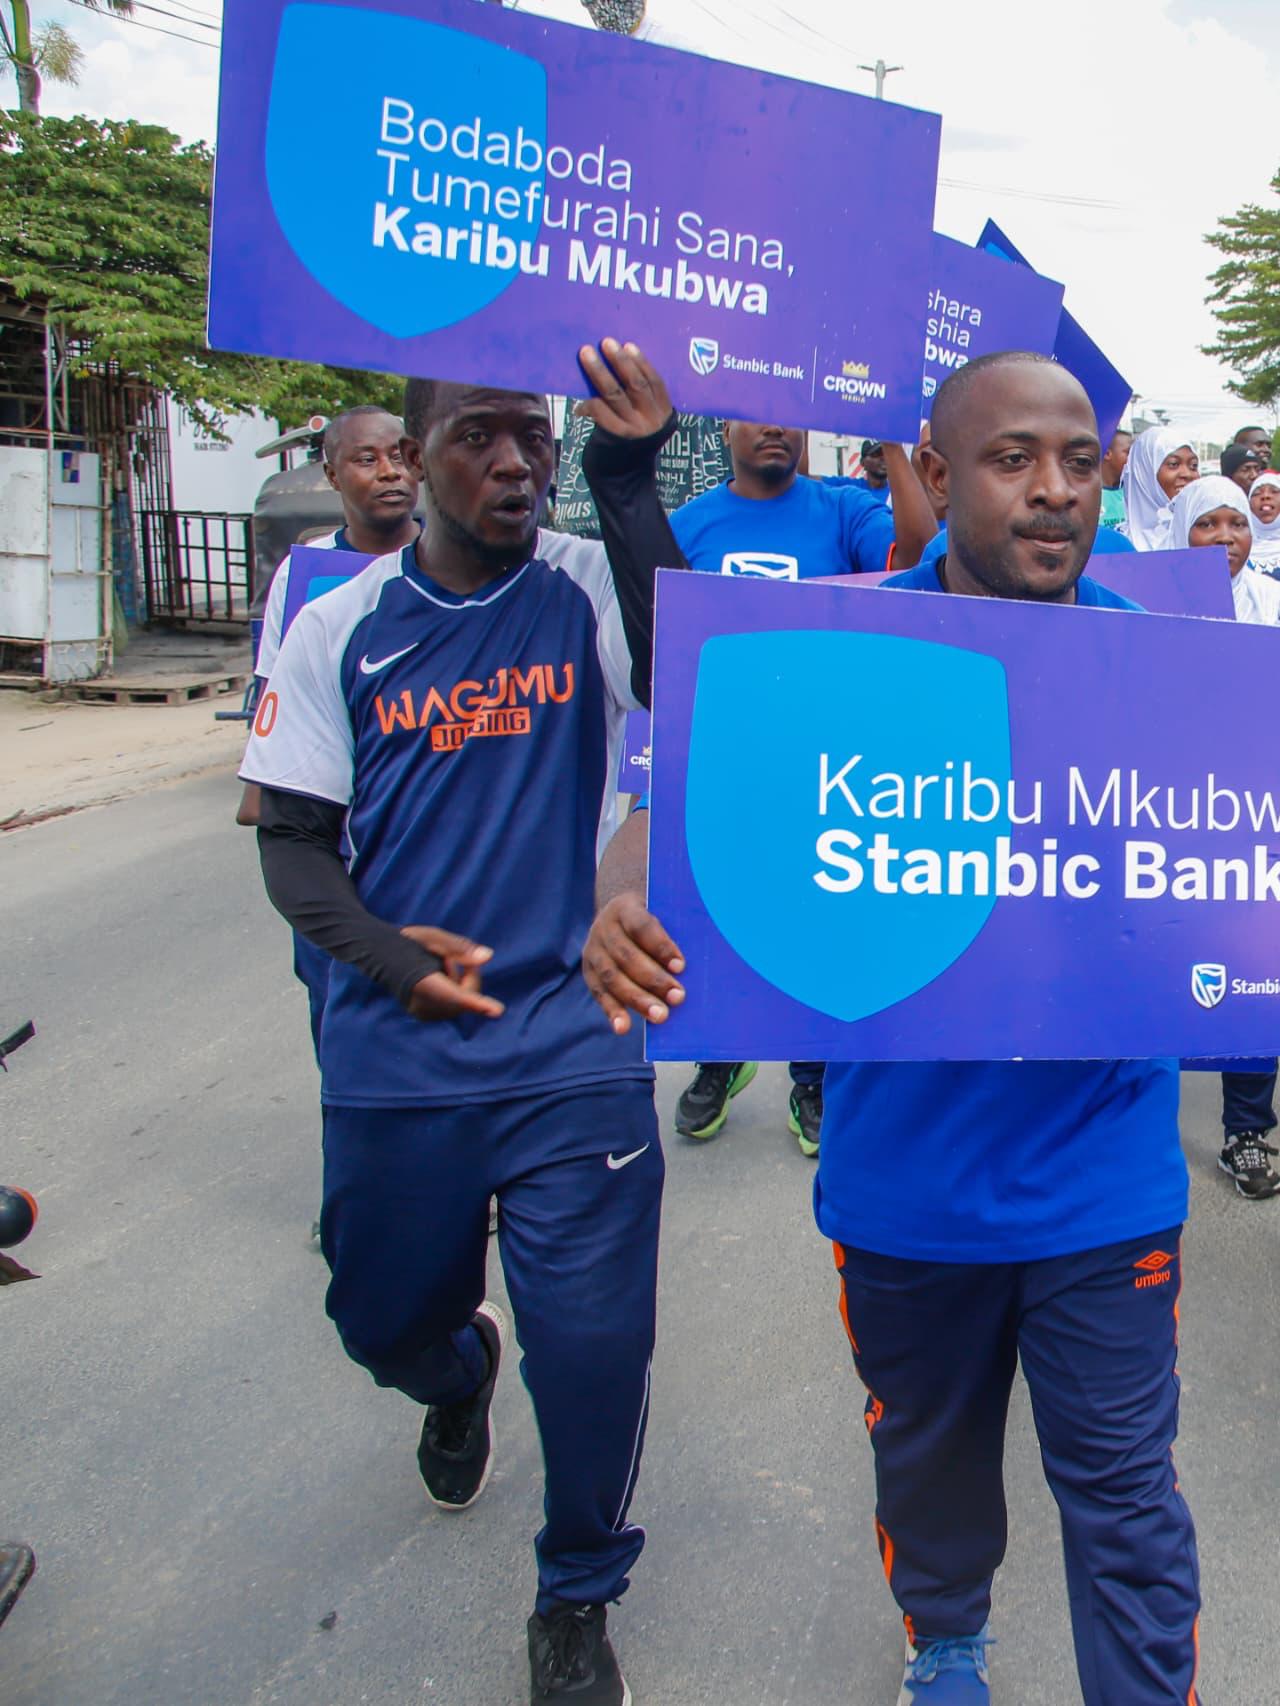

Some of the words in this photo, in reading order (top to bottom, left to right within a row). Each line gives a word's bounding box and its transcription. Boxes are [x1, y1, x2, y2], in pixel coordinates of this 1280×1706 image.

[381, 96, 632, 192] Bodaboda
[376, 149, 661, 248] Tumefurahi
[675, 211, 794, 278] Sana,
[373, 202, 550, 277] Karibu
[568, 239, 768, 316] Mkubwa
[723, 354, 770, 376] Stanbic
[773, 361, 805, 381] Bank
[823, 375, 886, 400] CROWN
[841, 394, 866, 405] MEDIA
[818, 753, 1043, 825] Karibu
[813, 828, 1101, 899] Stanbic
[1135, 1269, 1171, 1289] umbro
